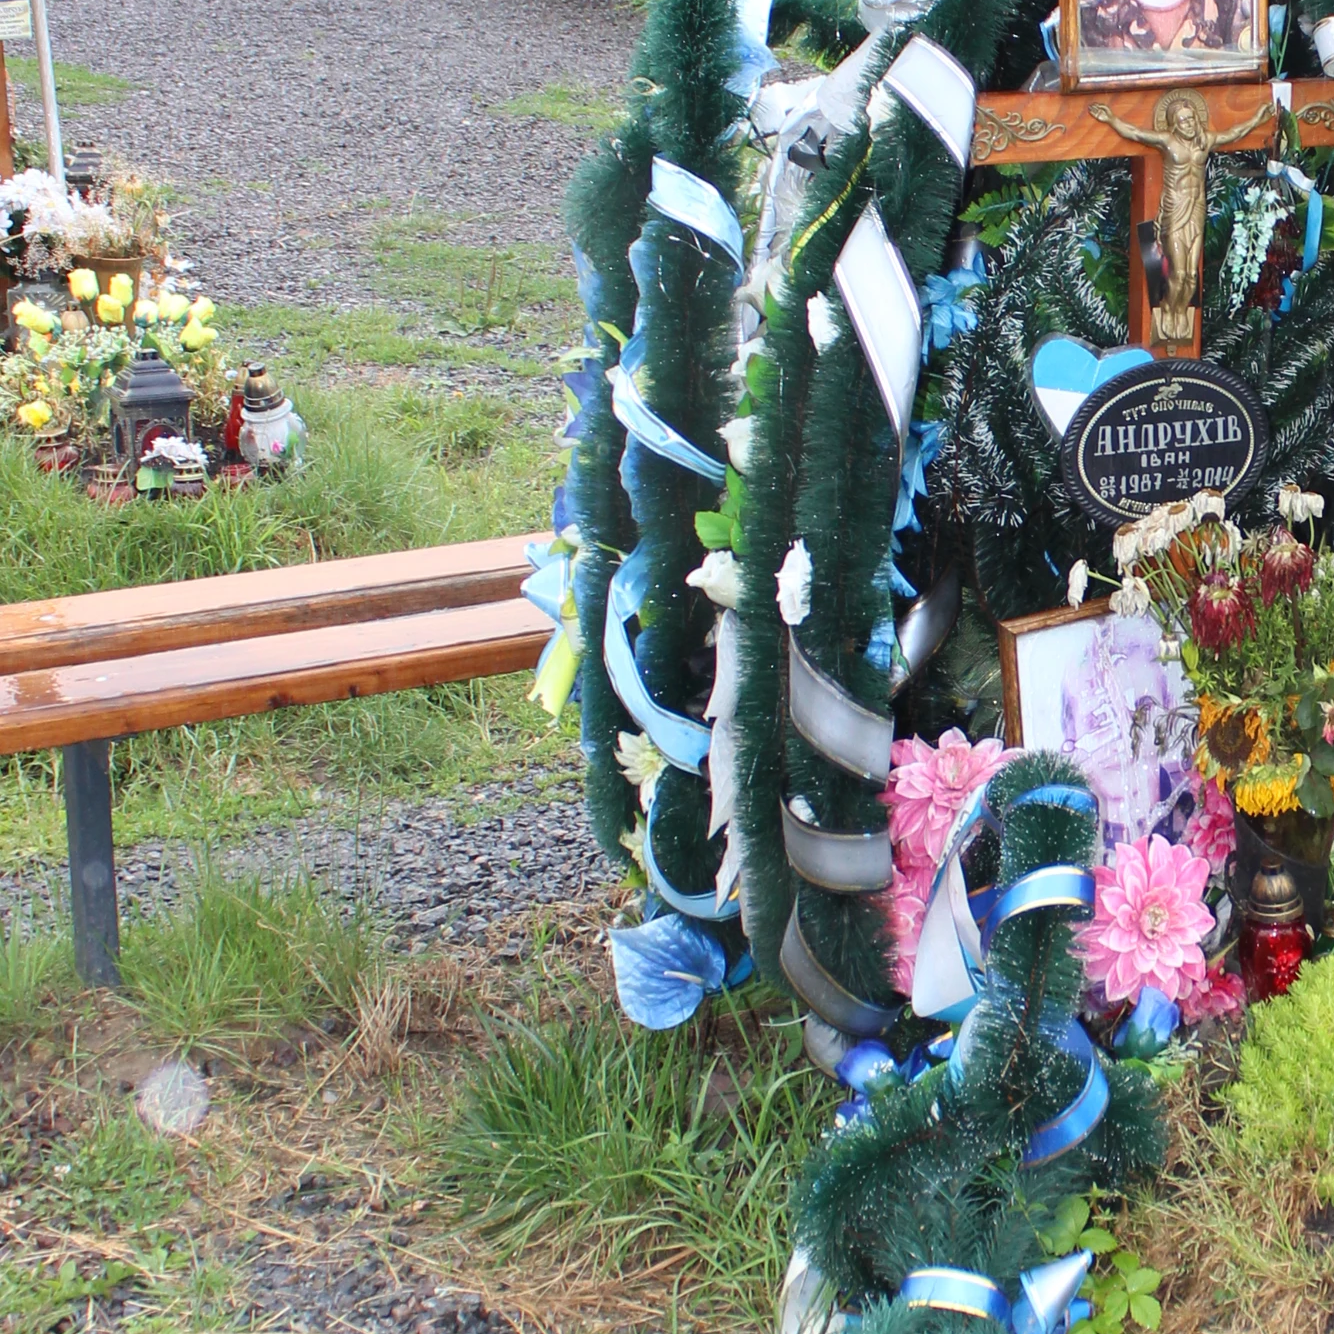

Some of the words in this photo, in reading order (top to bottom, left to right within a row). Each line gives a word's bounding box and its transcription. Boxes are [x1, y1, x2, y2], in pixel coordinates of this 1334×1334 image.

[1122, 403, 1148, 421] ТУТ
[1094, 412, 1242, 456] АНДРУХІВ
[1141, 450, 1190, 467] ІВАН
[1120, 473, 1162, 494] 1987
[1192, 466, 1234, 488] 2014
